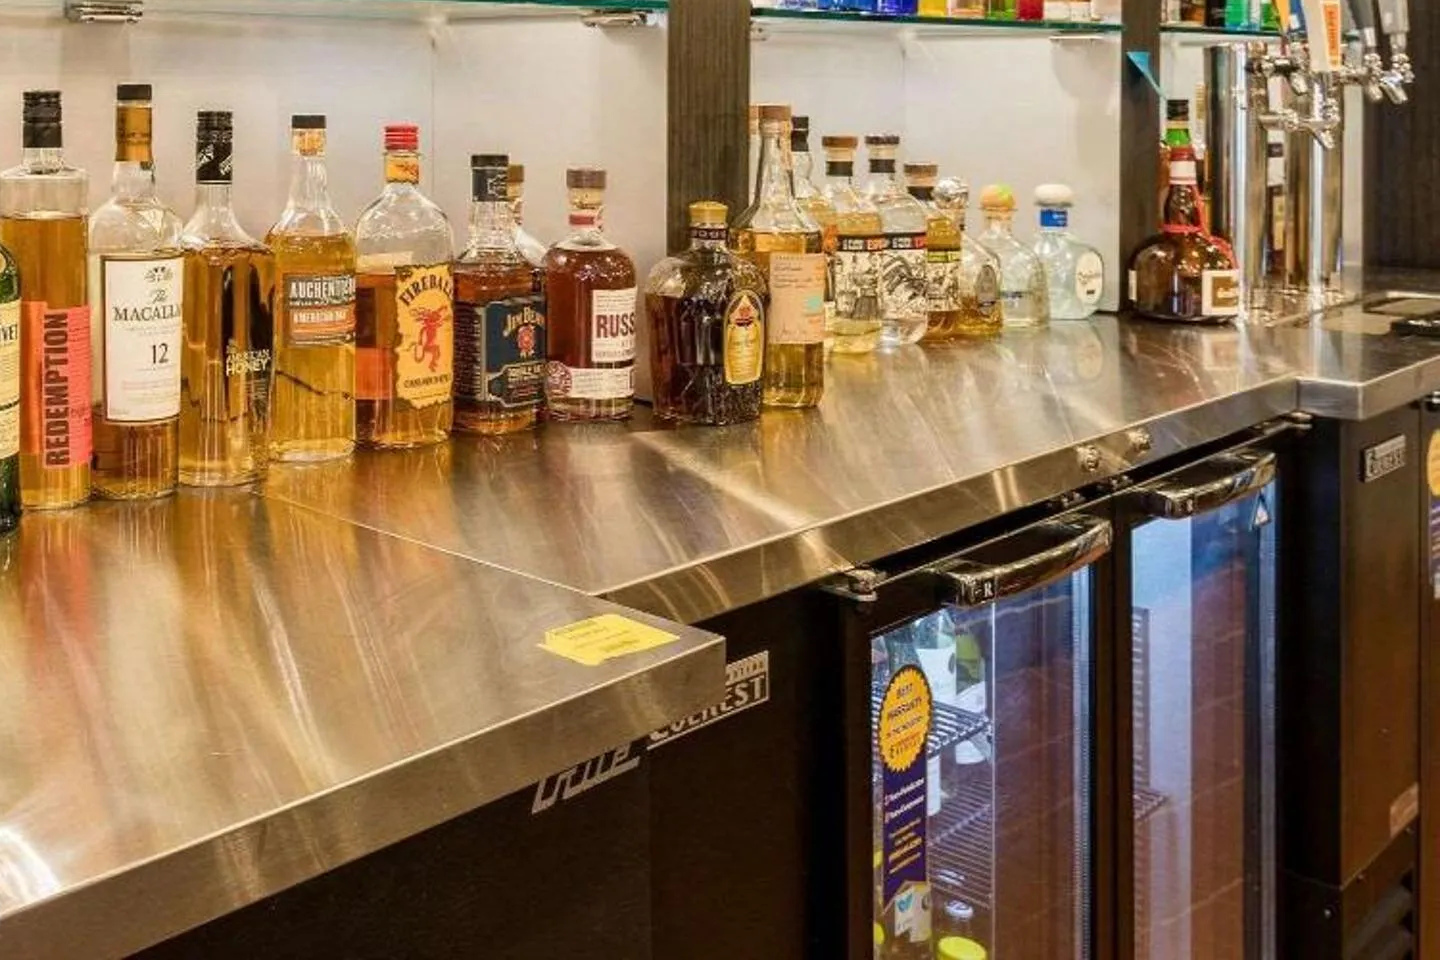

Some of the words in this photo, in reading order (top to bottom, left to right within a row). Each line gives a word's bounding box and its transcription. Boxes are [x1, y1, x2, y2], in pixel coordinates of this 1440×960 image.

[113, 305, 181, 321] MACALL
[596, 312, 635, 339] RUSS
[152, 342, 169, 364] 12
[226, 357, 268, 377] HONEY
[44, 312, 71, 467] REDEMPTION
